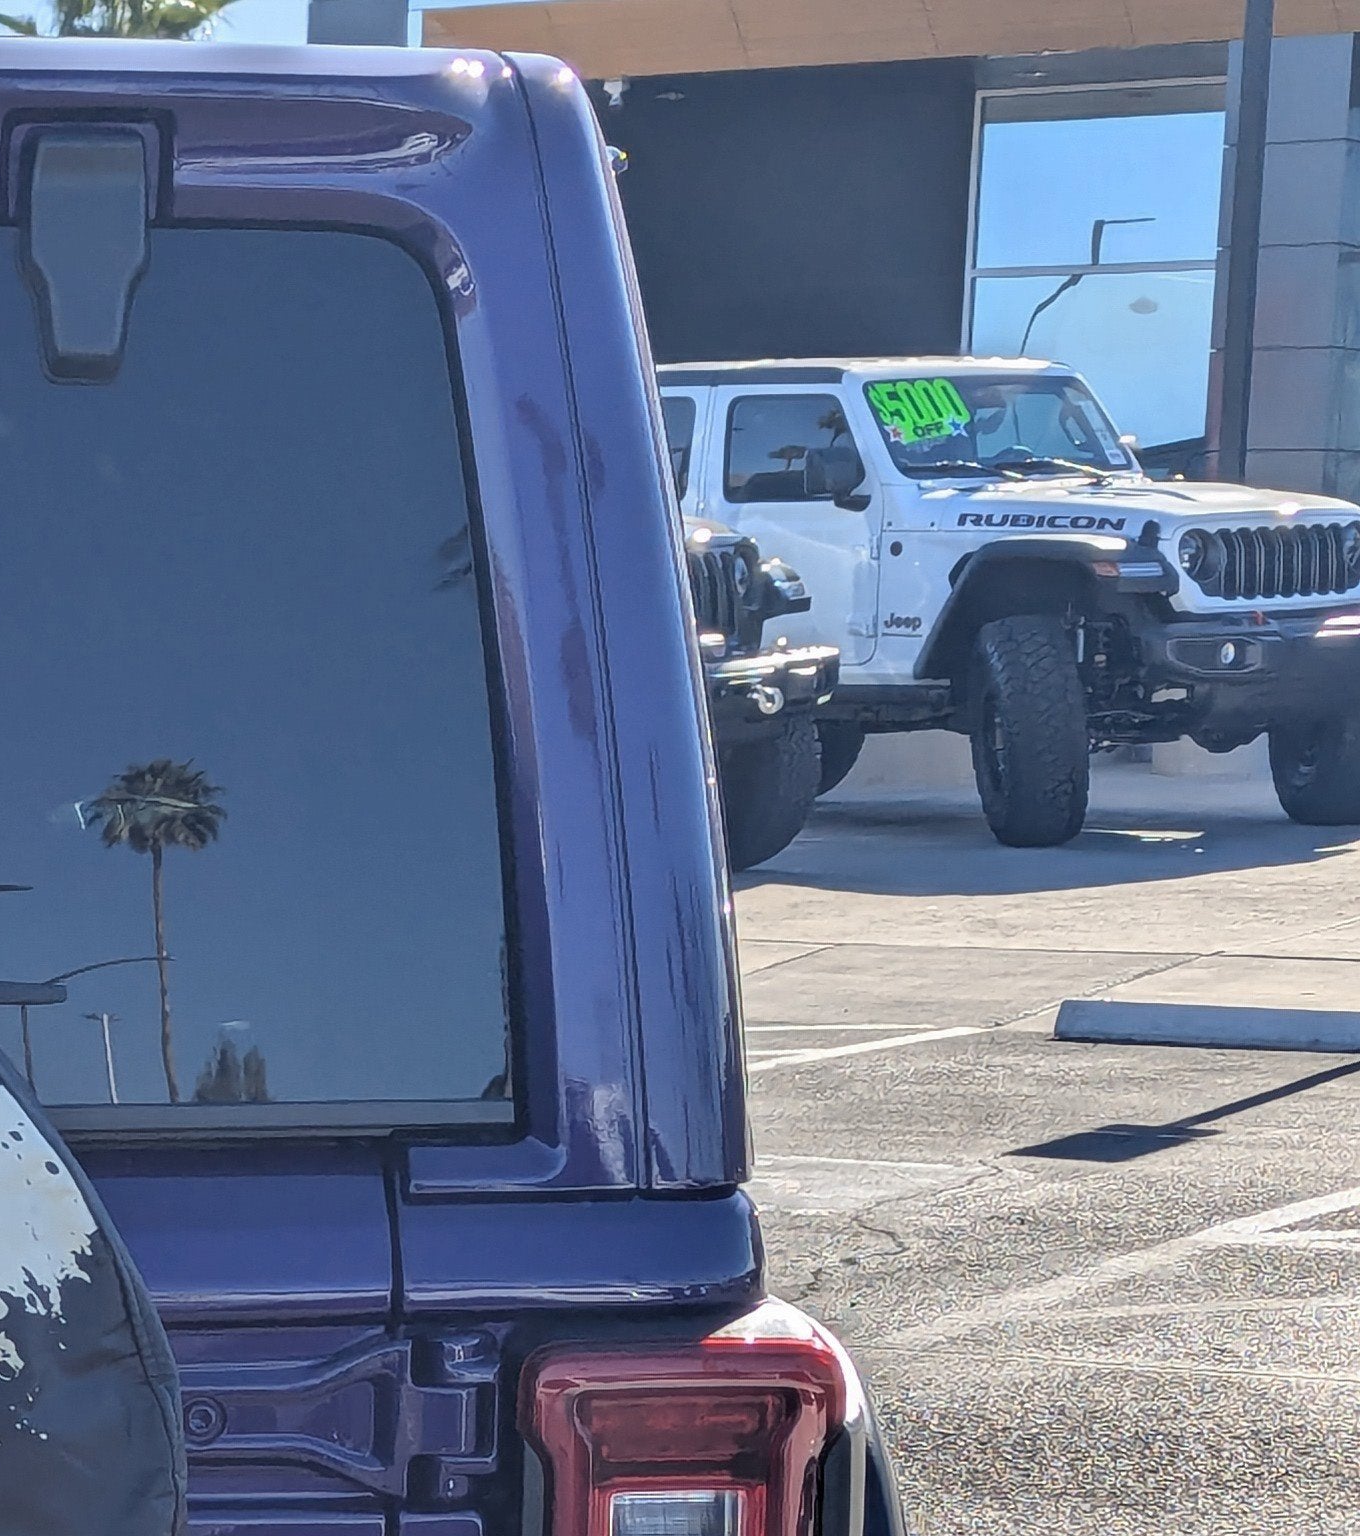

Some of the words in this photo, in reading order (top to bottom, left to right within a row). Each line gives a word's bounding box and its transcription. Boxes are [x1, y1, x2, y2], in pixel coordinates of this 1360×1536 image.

[868, 377, 971, 432] $5000
[912, 421, 944, 438] OFF
[957, 513, 1127, 531] RUBICON
[884, 612, 922, 631] Jeep
